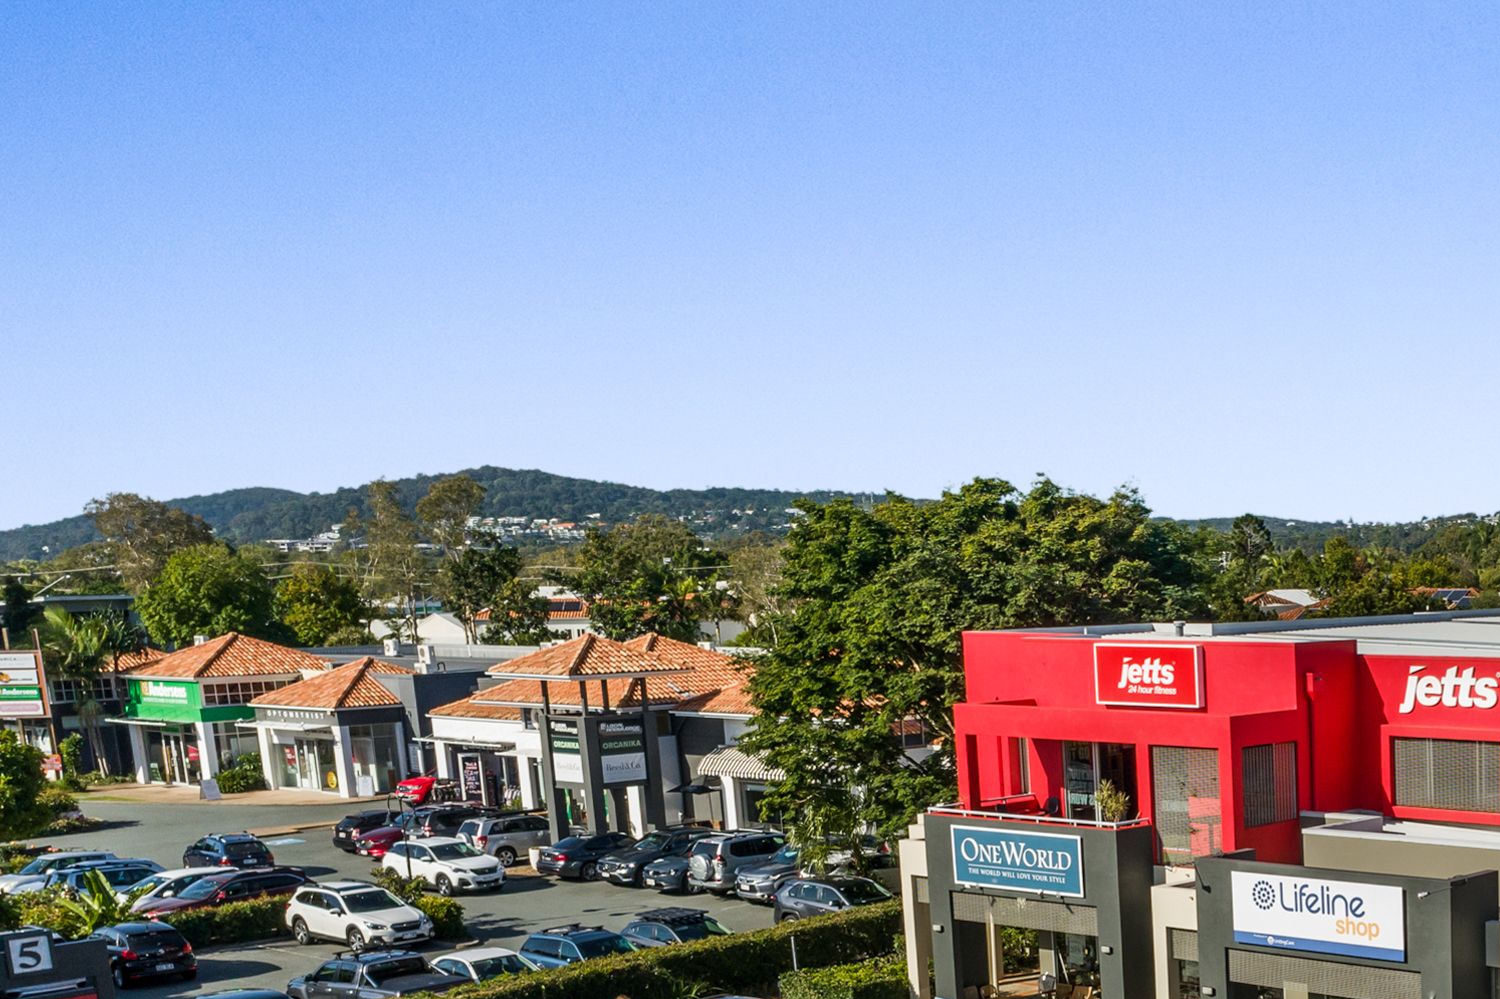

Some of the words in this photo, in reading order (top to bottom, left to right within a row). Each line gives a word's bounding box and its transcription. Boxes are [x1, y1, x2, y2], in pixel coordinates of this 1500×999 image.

[1117, 657, 1175, 689] jetts
[1128, 685, 1138, 694] 24
[1138, 685, 1154, 695] hour
[1154, 685, 1177, 696] fitness
[1398, 665, 1499, 714] jetts
[968, 867, 980, 875] THE
[980, 868, 1001, 877] WORLD
[1001, 871, 1015, 879] WILL
[1016, 872, 1031, 880] LOVE
[1031, 874, 1048, 882] YOUR
[1049, 876, 1066, 885] STYLE
[1279, 881, 1365, 919] Lifeline
[1335, 917, 1380, 941] shop
[18, 940, 42, 969] 5
